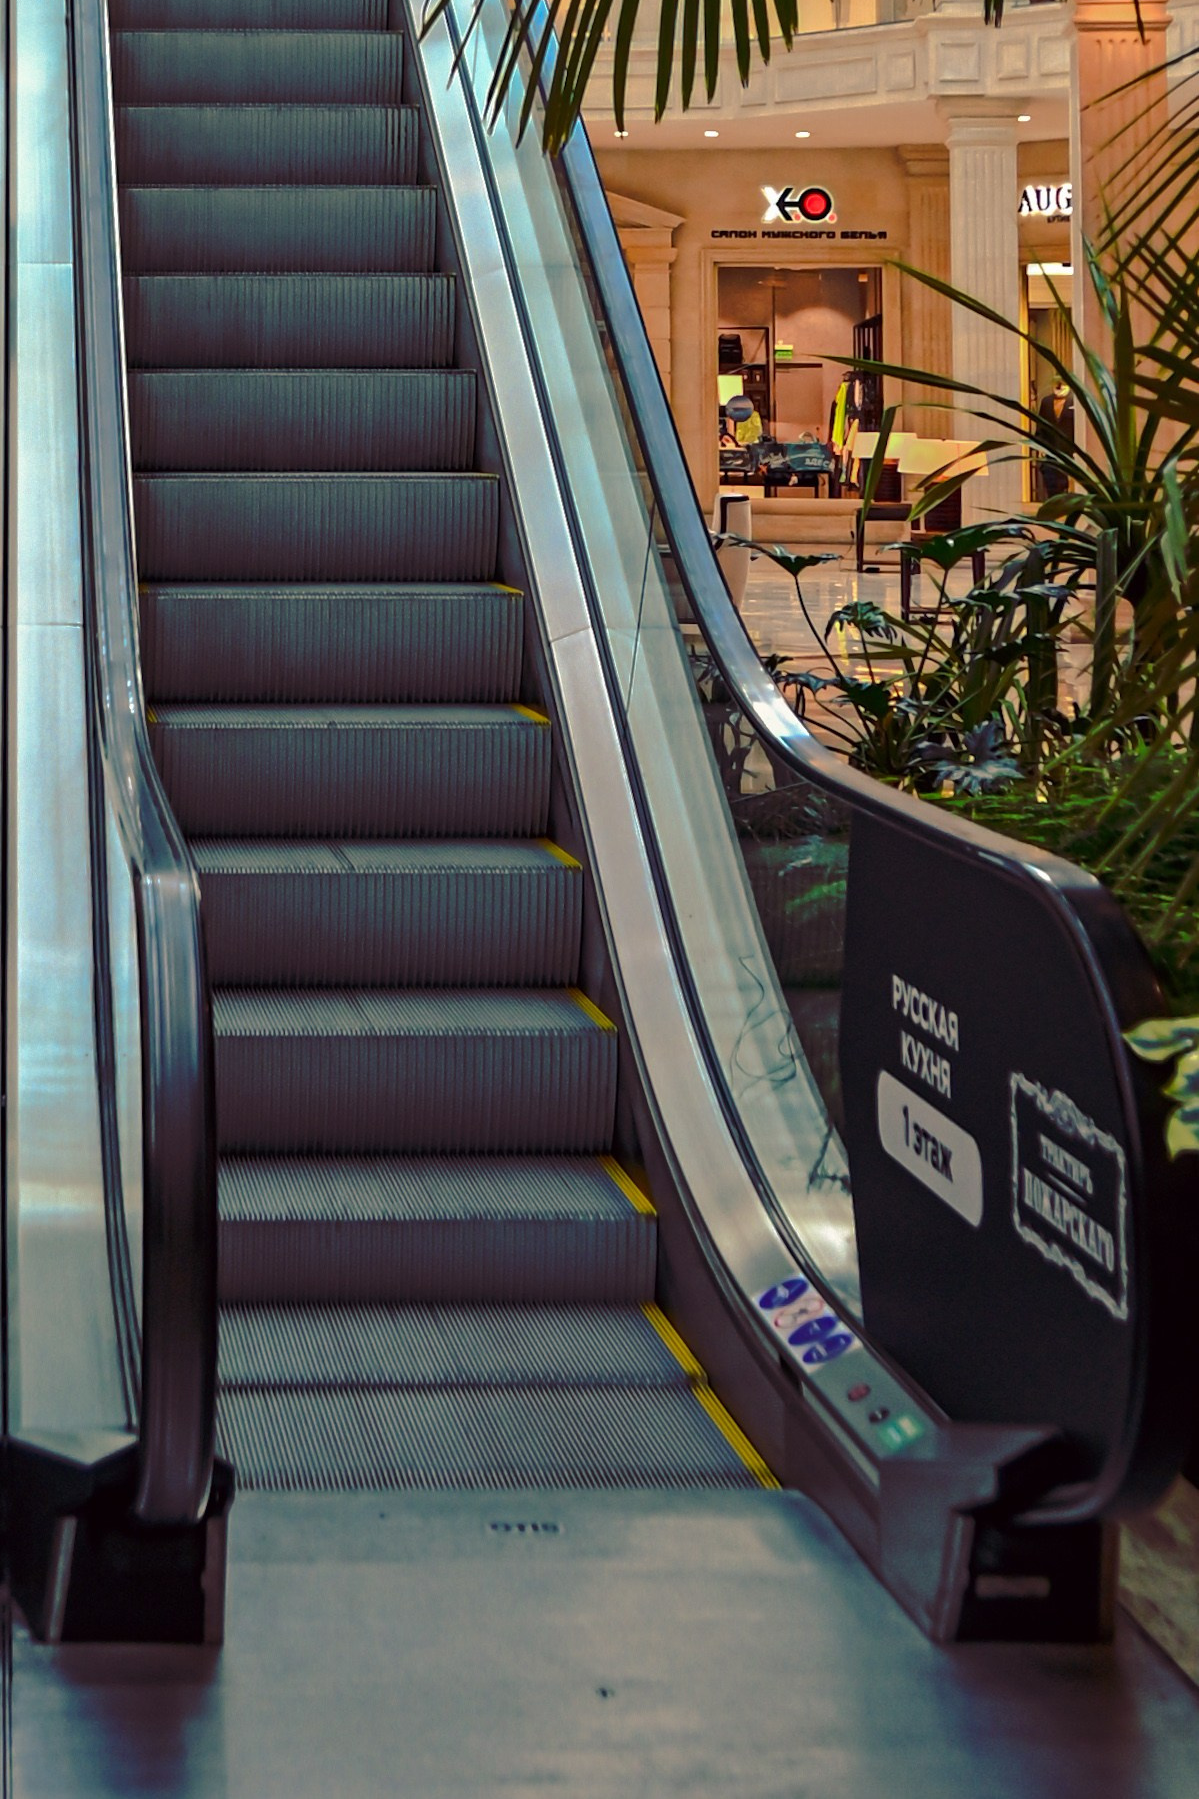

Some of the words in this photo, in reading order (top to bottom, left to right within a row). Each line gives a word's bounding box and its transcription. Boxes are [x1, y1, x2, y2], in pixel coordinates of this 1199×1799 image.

[711, 230, 757, 239] САЛОН
[762, 230, 836, 239] МУЖСКОГО
[841, 230, 887, 239] БЕЛЬЯ
[892, 974, 959, 1051] РУССКАЯ
[901, 1030, 951, 1099] КУХНЯ
[902, 1105, 910, 1148] 1
[913, 1122, 953, 1183] этаж
